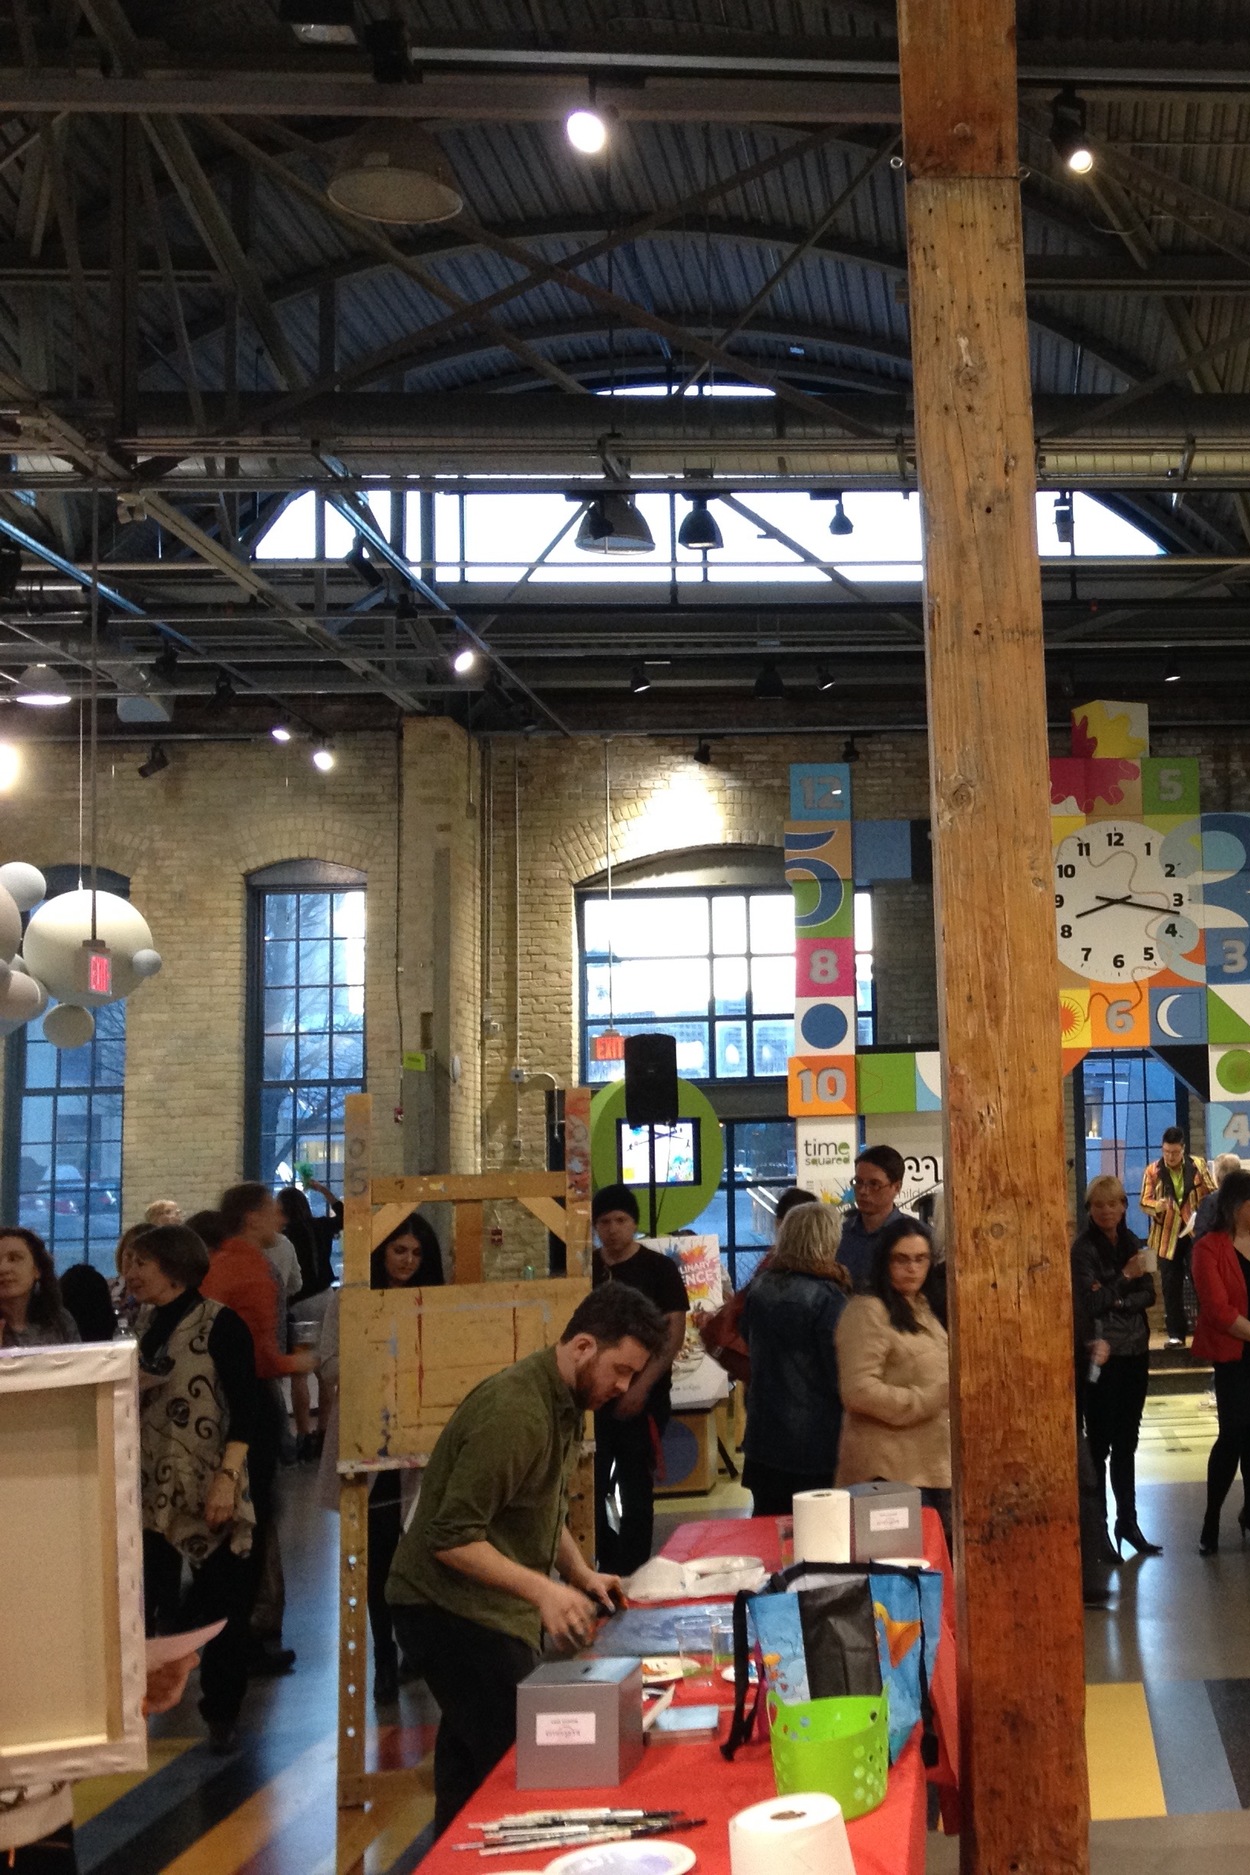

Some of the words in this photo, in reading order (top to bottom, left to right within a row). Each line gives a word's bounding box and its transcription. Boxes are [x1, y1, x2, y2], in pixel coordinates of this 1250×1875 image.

[799, 775, 843, 810] 12
[1159, 769, 1183, 801] 5
[1106, 832, 1125, 847] 12
[1077, 842, 1091, 857] 11
[1145, 842, 1151, 856] 1
[1056, 864, 1076, 878] 10
[1164, 864, 1176, 878] 2
[1173, 893, 1184, 907] 3
[1060, 924, 1073, 939] 8
[1165, 923, 1178, 938] 4
[1081, 947, 1092, 962] 7
[1112, 954, 1125, 968] 6
[1143, 947, 1154, 961] 5
[1222, 939, 1249, 974] 3
[809, 948, 839, 985] 8
[1105, 999, 1135, 1034] 6
[797, 1067, 847, 1104] 10
[804, 1138, 850, 1156] time
[805, 1155, 850, 1166] squared
